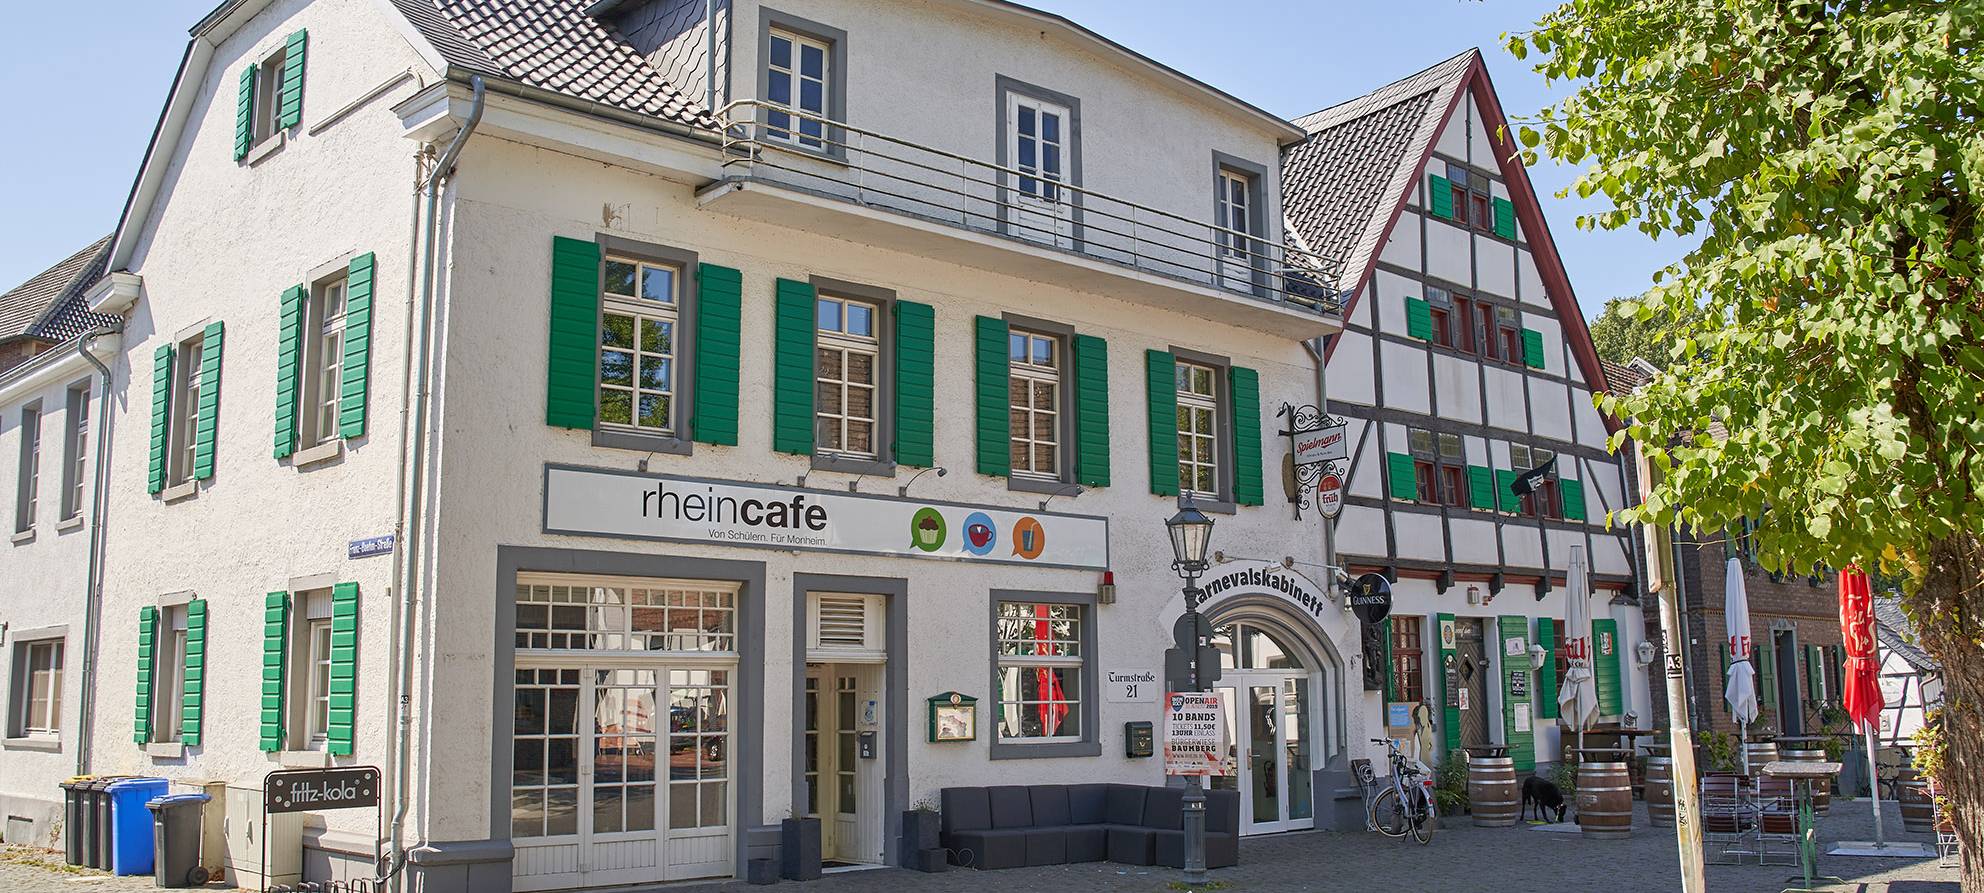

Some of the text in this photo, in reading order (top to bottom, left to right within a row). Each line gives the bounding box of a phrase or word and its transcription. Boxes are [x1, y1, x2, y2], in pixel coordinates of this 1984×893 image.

[1297, 433, 1342, 456] Spielmann
[643, 482, 827, 531] rheincafe
[708, 529, 827, 546] Von Schülern. Für Monheim.
[1196, 568, 1324, 617] arnevalskabinett
[1353, 596, 1385, 605] GUINNESS
[1667, 656, 1682, 670] A3
[1108, 671, 1155, 683] Turmstraße
[1126, 684, 1138, 698] 21
[1172, 713, 1216, 721] 10 BANDS
[290, 780, 356, 803] fritz-kola
